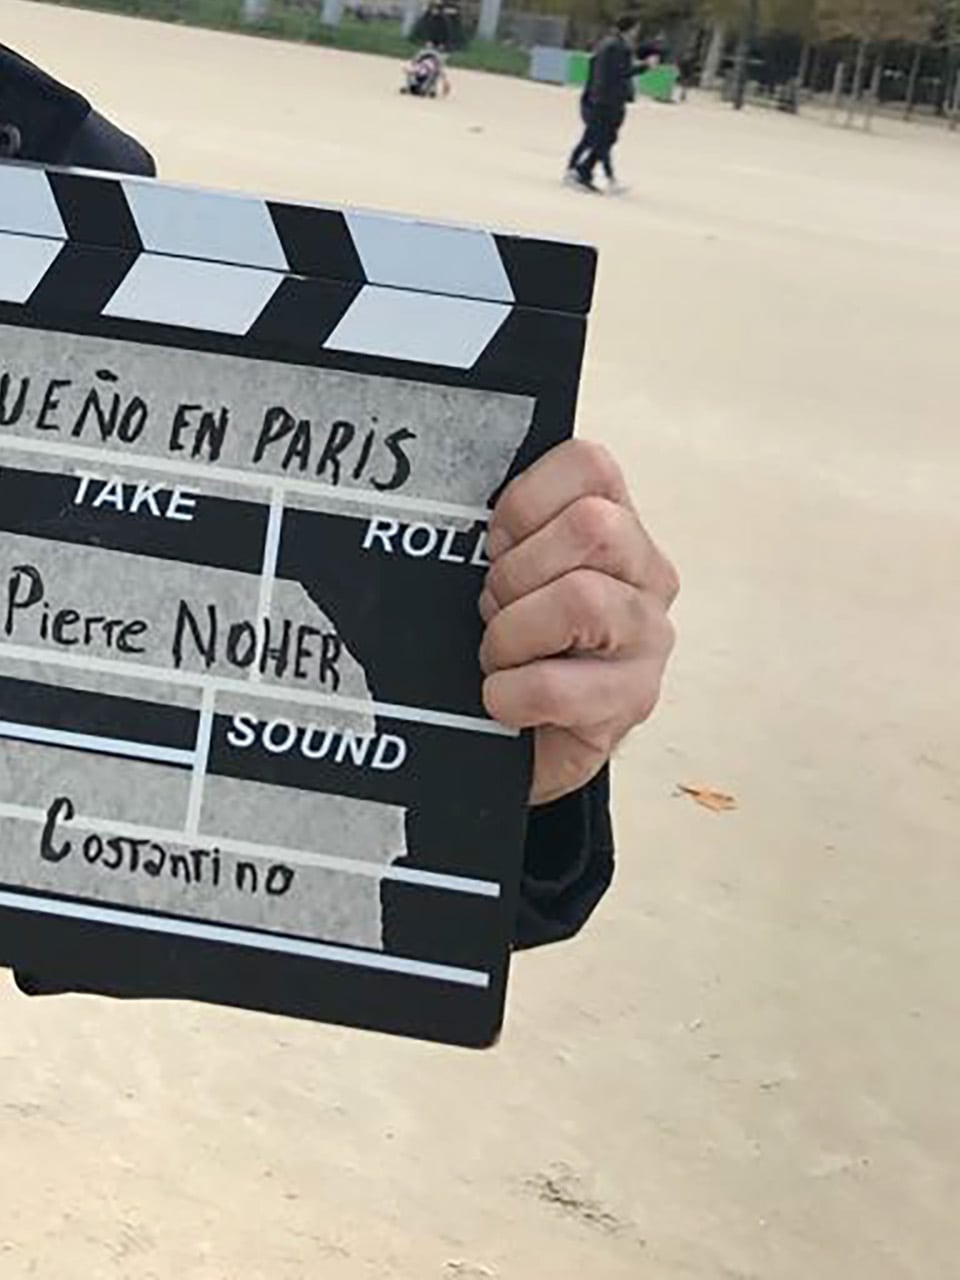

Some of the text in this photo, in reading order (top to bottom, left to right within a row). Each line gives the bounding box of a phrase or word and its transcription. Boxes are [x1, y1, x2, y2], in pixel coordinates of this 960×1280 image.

[168, 403, 230, 462] EN
[252, 405, 417, 491] PARIS
[72, 469, 201, 522] TAKE
[361, 515, 491, 567] ROLL
[4, 564, 148, 655] Pierre
[171, 598, 342, 692] NOHER
[226, 712, 408, 771] SOUND
